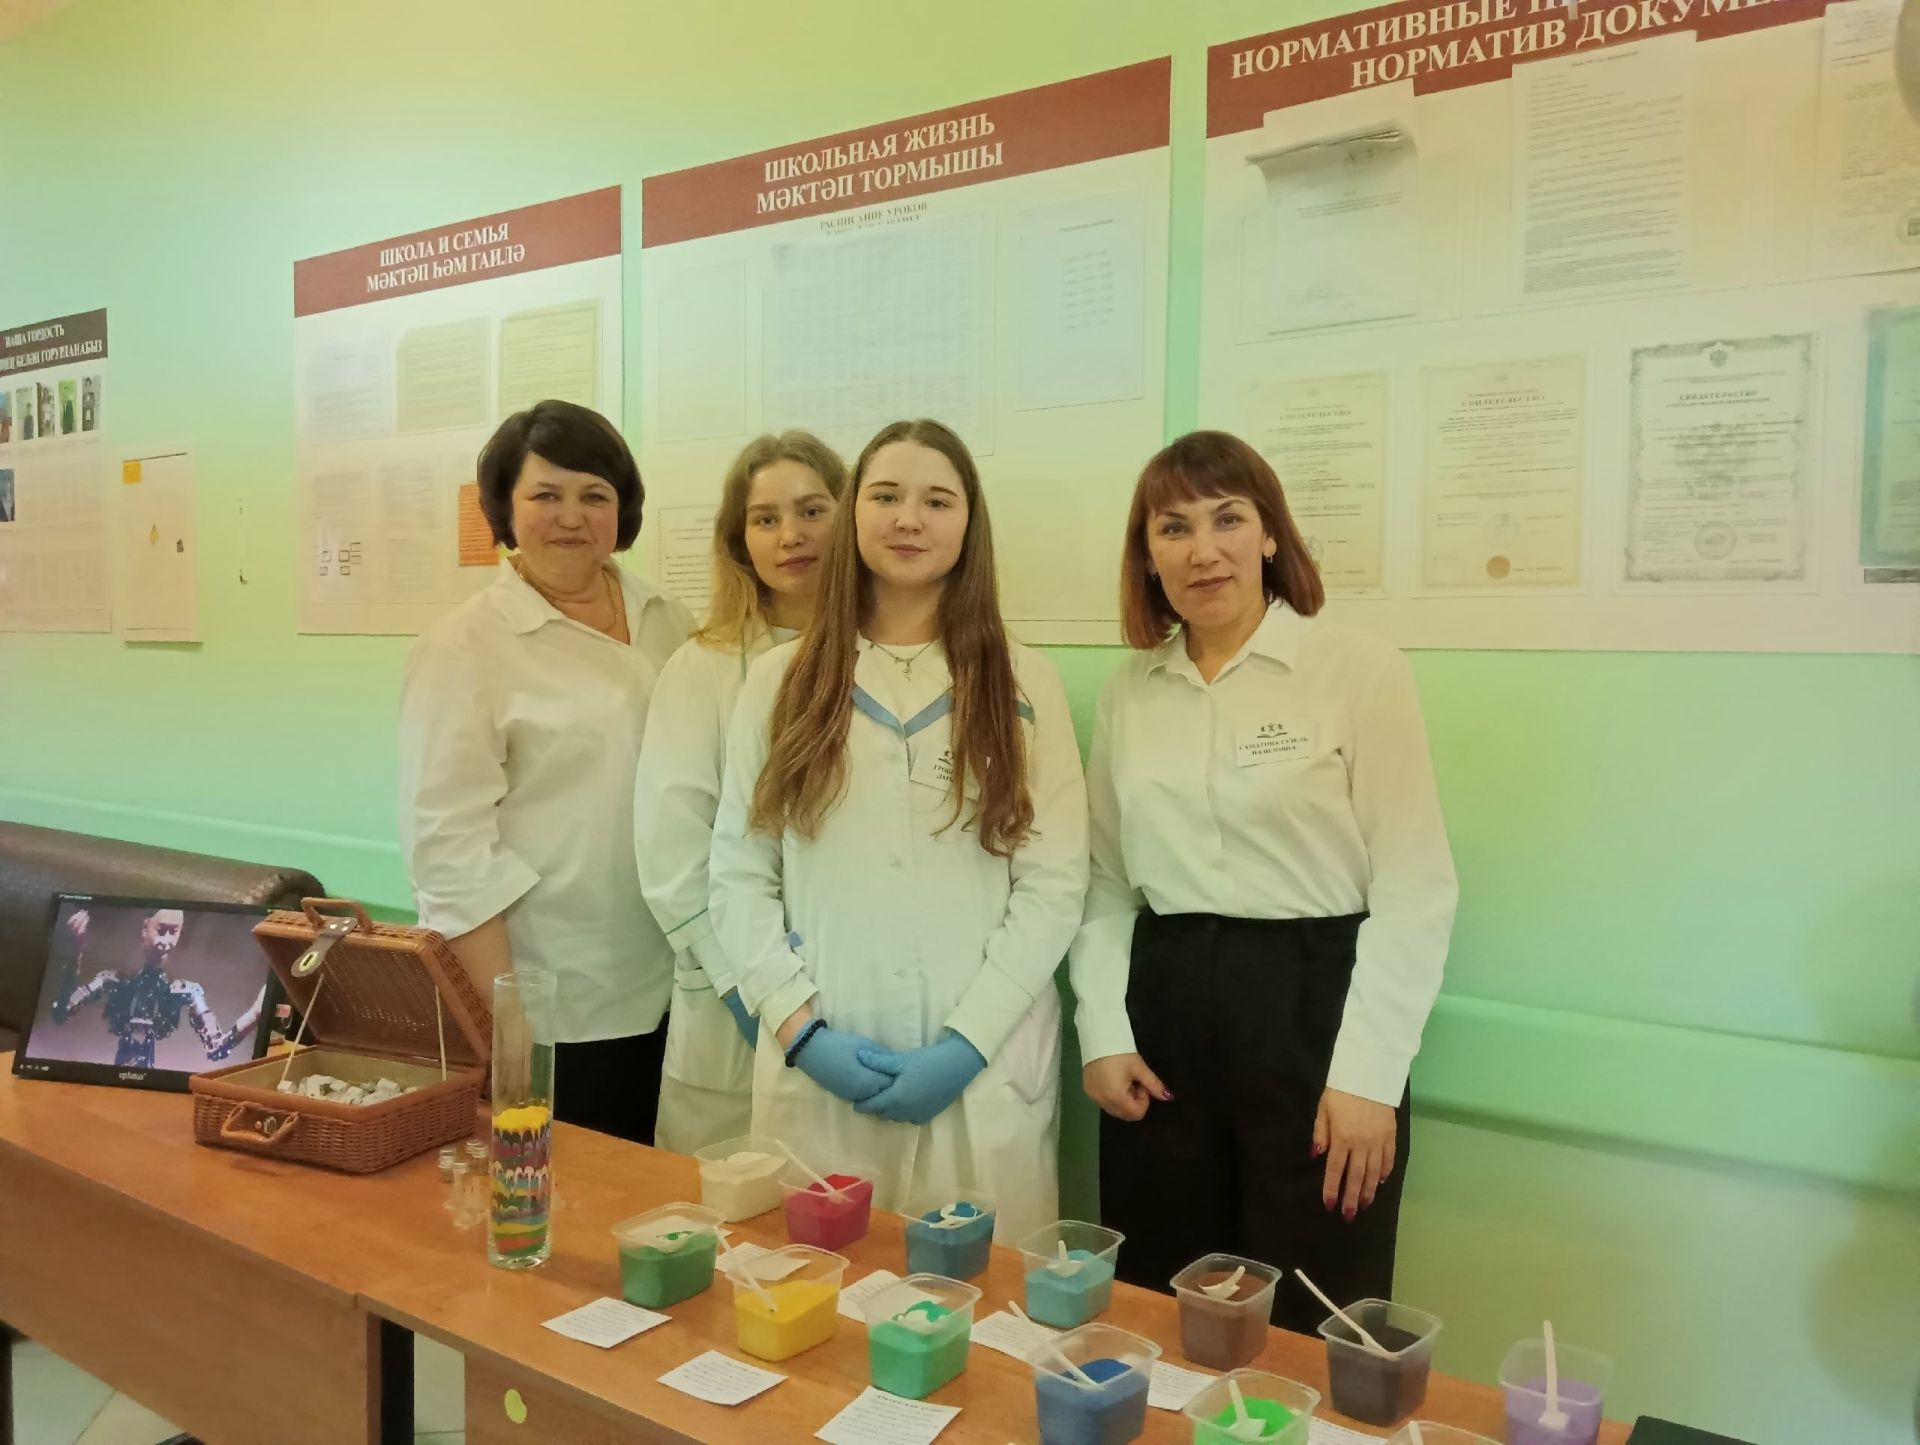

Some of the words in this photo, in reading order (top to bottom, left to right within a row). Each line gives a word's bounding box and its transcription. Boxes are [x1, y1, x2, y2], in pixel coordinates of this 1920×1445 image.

[1231, 0, 1518, 79] НОРМАТИВНЫЕ
[1351, 19, 1567, 88] НОРМАТИВ
[756, 174, 854, 214] МӘКТӘП
[859, 143, 1004, 192] ТОРМЫШЫ
[764, 134, 898, 183] ШКОЛЬНАЯ
[904, 113, 996, 153] ЖИЗНЬ
[366, 264, 429, 292] МӘКТӘП
[471, 244, 525, 271] ГАИЛӘ
[380, 240, 435, 267] ШКОЛА
[438, 235, 449, 254] И
[453, 223, 509, 251] СЕМЬЯ
